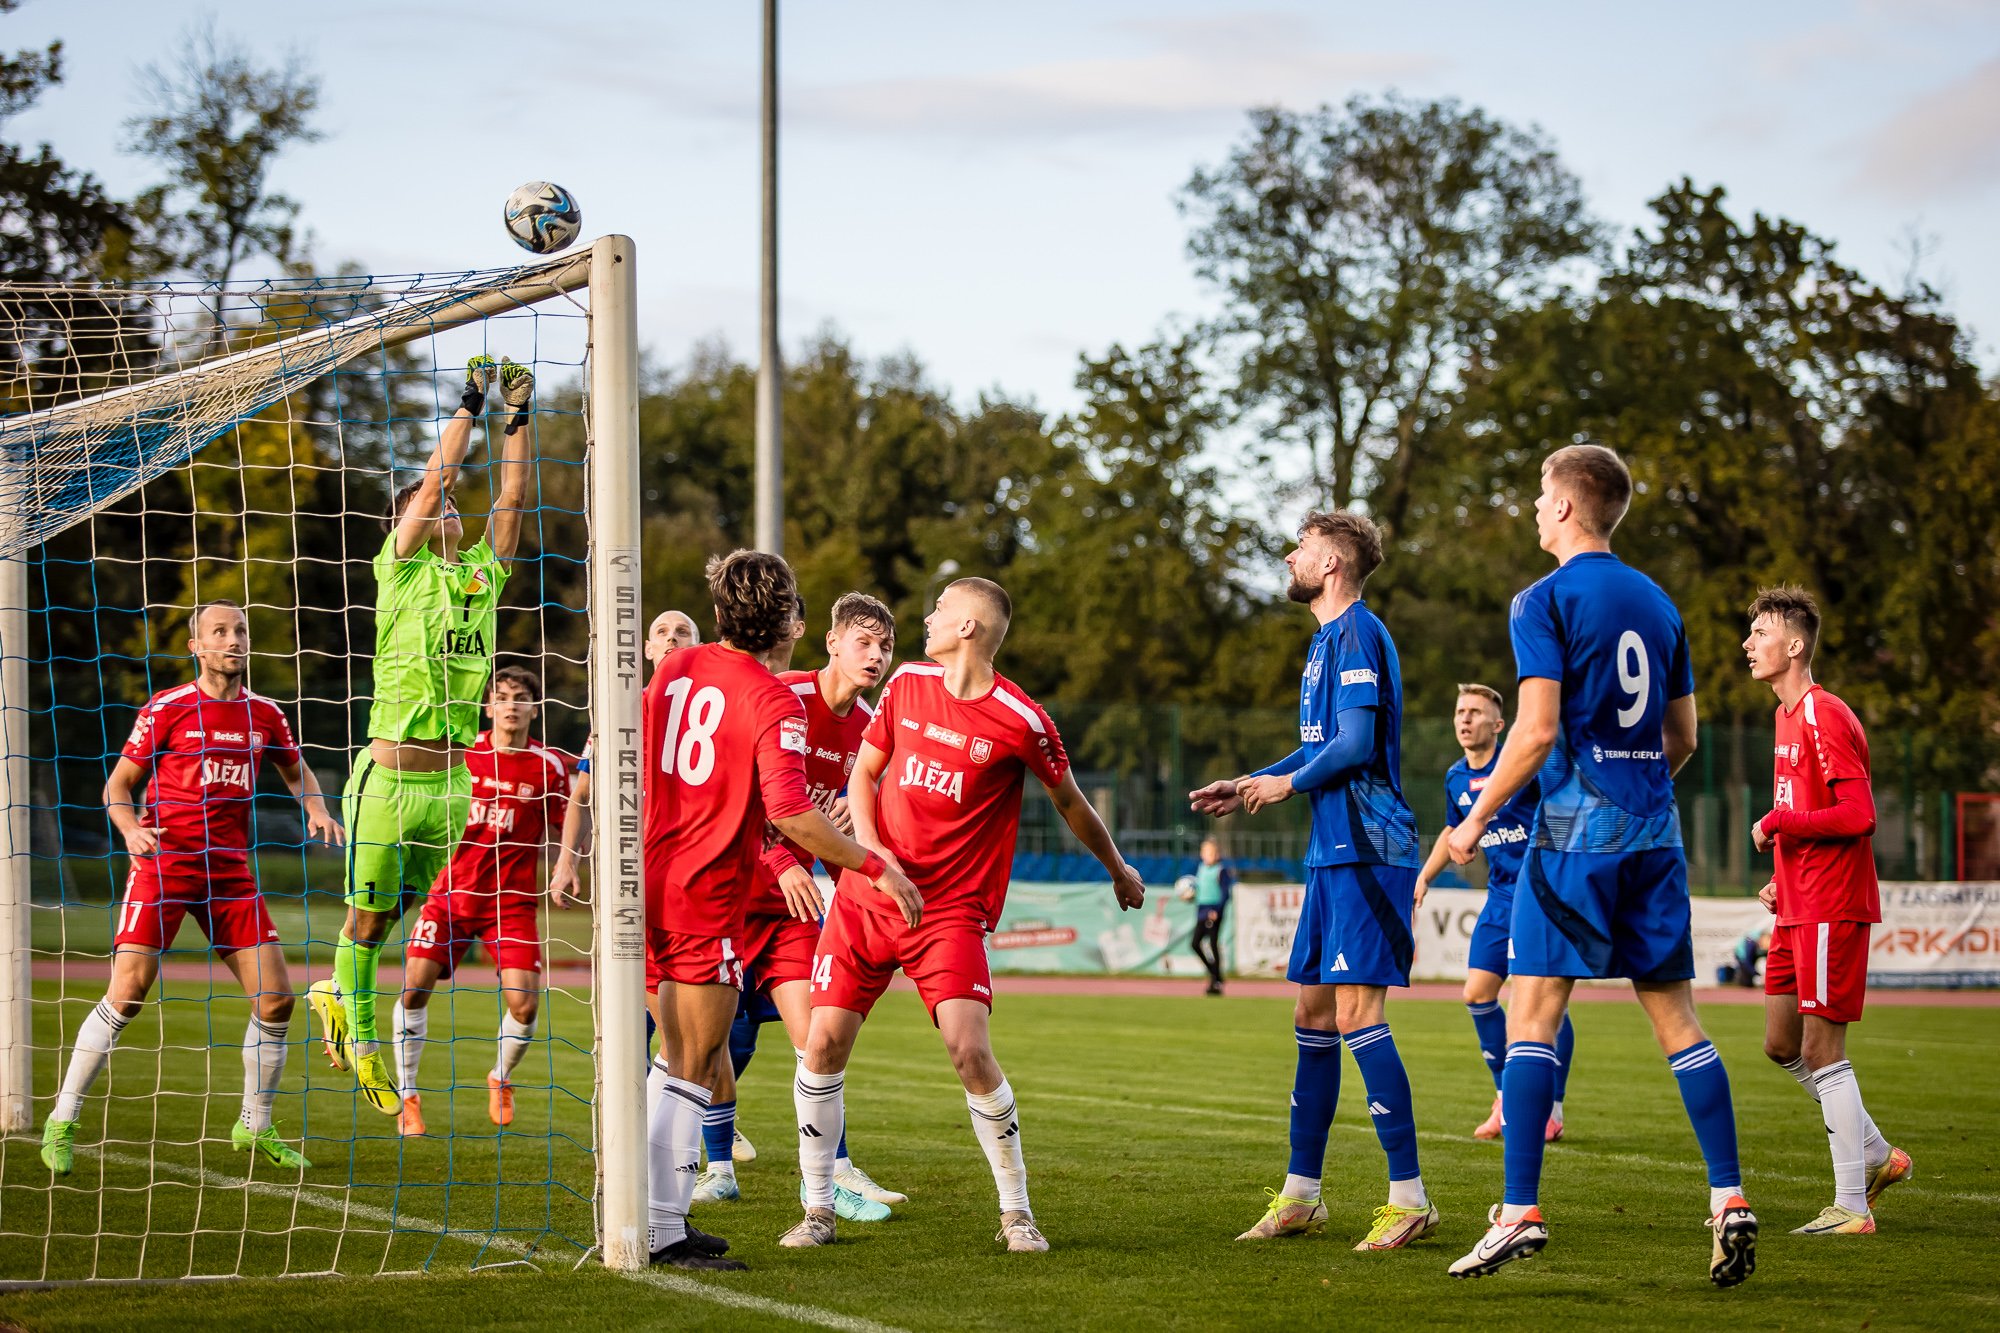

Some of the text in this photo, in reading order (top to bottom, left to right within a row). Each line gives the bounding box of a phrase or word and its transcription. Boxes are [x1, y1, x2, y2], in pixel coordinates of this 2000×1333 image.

[616, 586, 636, 690] SPORT
[1617, 630, 1650, 728] 9
[661, 676, 726, 786] 18
[901, 717, 919, 730] JAKO
[213, 731, 244, 742] Betclic
[926, 727, 962, 746] Betclic
[816, 747, 842, 762] Betclic
[930, 760, 942, 769] 1945
[1604, 750, 1630, 759] TERMY
[200, 757, 250, 791] ŚLĘZA
[899, 754, 964, 804] ŚLĘZA
[618, 728, 638, 898] TRANSFER
[365, 881, 375, 904] 1
[413, 919, 438, 949] 13
[972, 983, 990, 996] JAKO
[1801, 1000, 1816, 1008] JAKO
